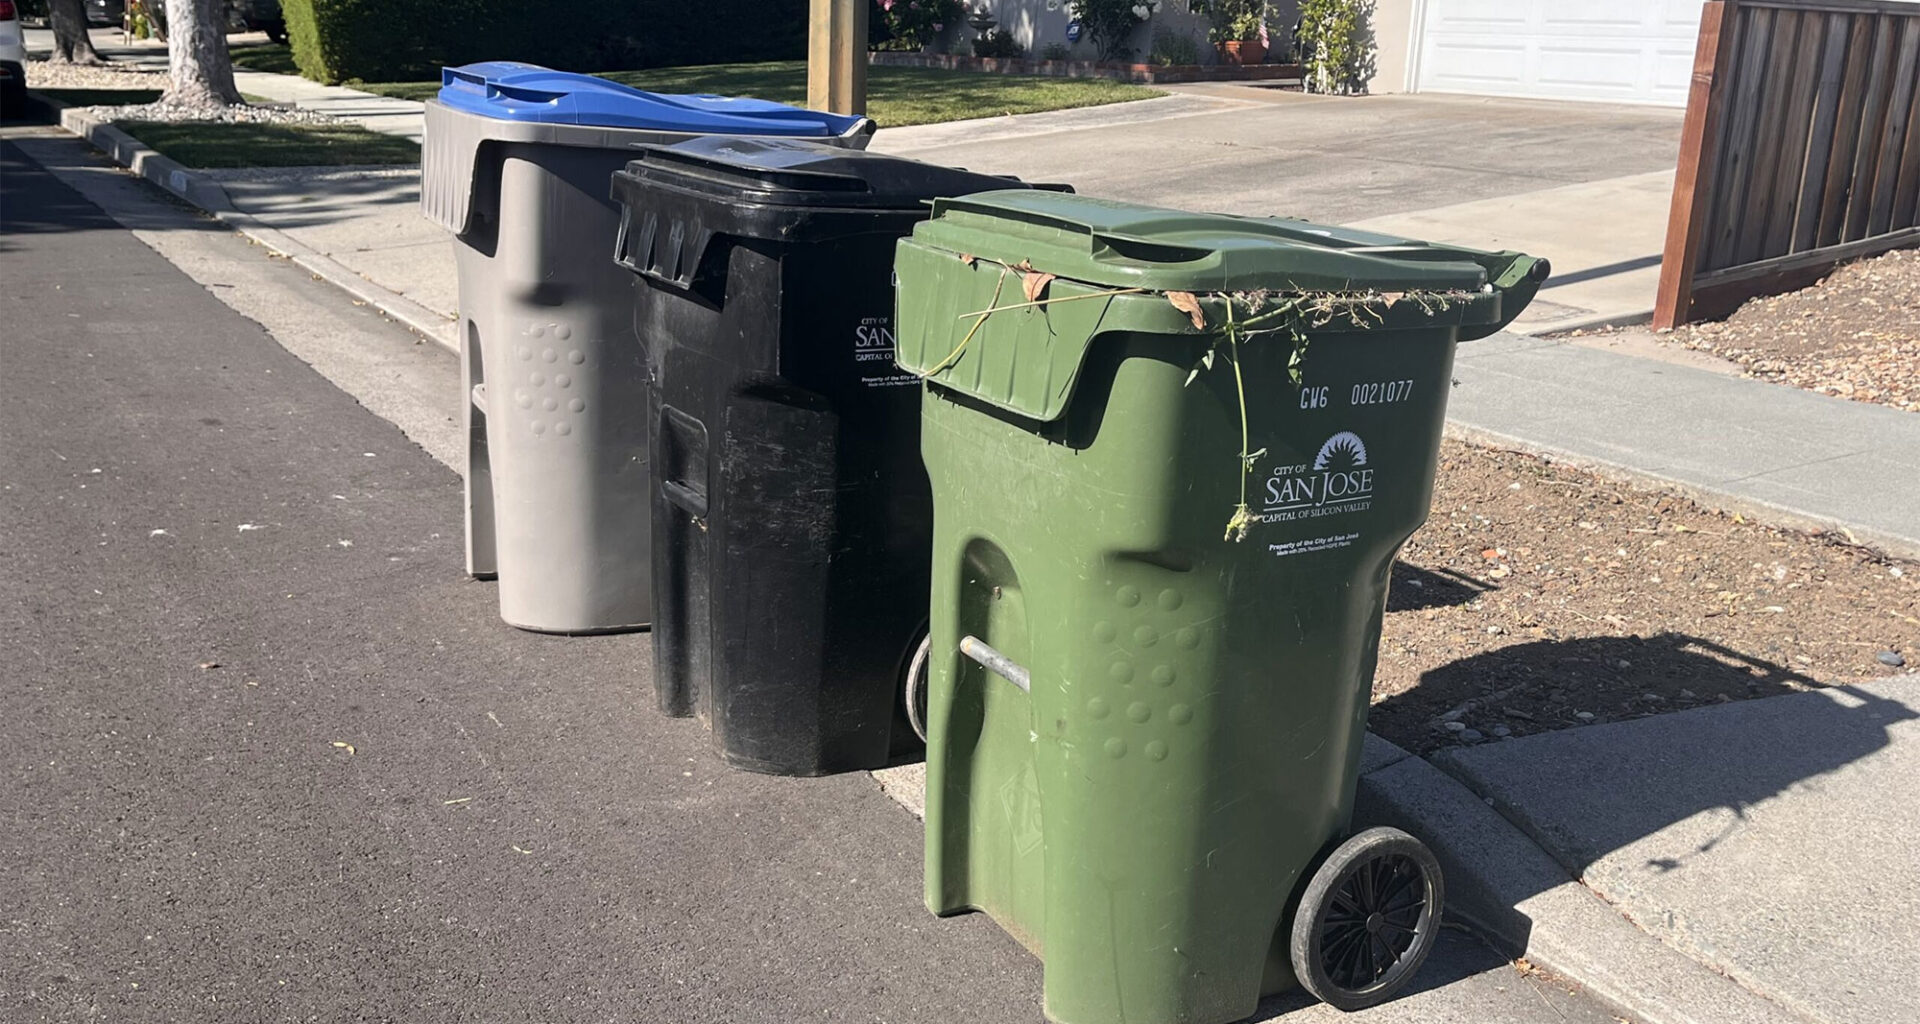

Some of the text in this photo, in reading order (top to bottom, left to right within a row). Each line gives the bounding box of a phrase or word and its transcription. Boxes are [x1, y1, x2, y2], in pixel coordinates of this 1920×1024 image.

[861, 317, 877, 325] CITY
[856, 326, 896, 347] SAN
[855, 353, 883, 361] CAPITAL
[1300, 380, 1413, 409] GW6 0021077
[1273, 464, 1307, 476] CITY OF
[1265, 469, 1374, 507] SAN JOSE
[1262, 502, 1372, 523] CAPITAL OF SILICON VALLEY
[1269, 542, 1295, 551] Property
